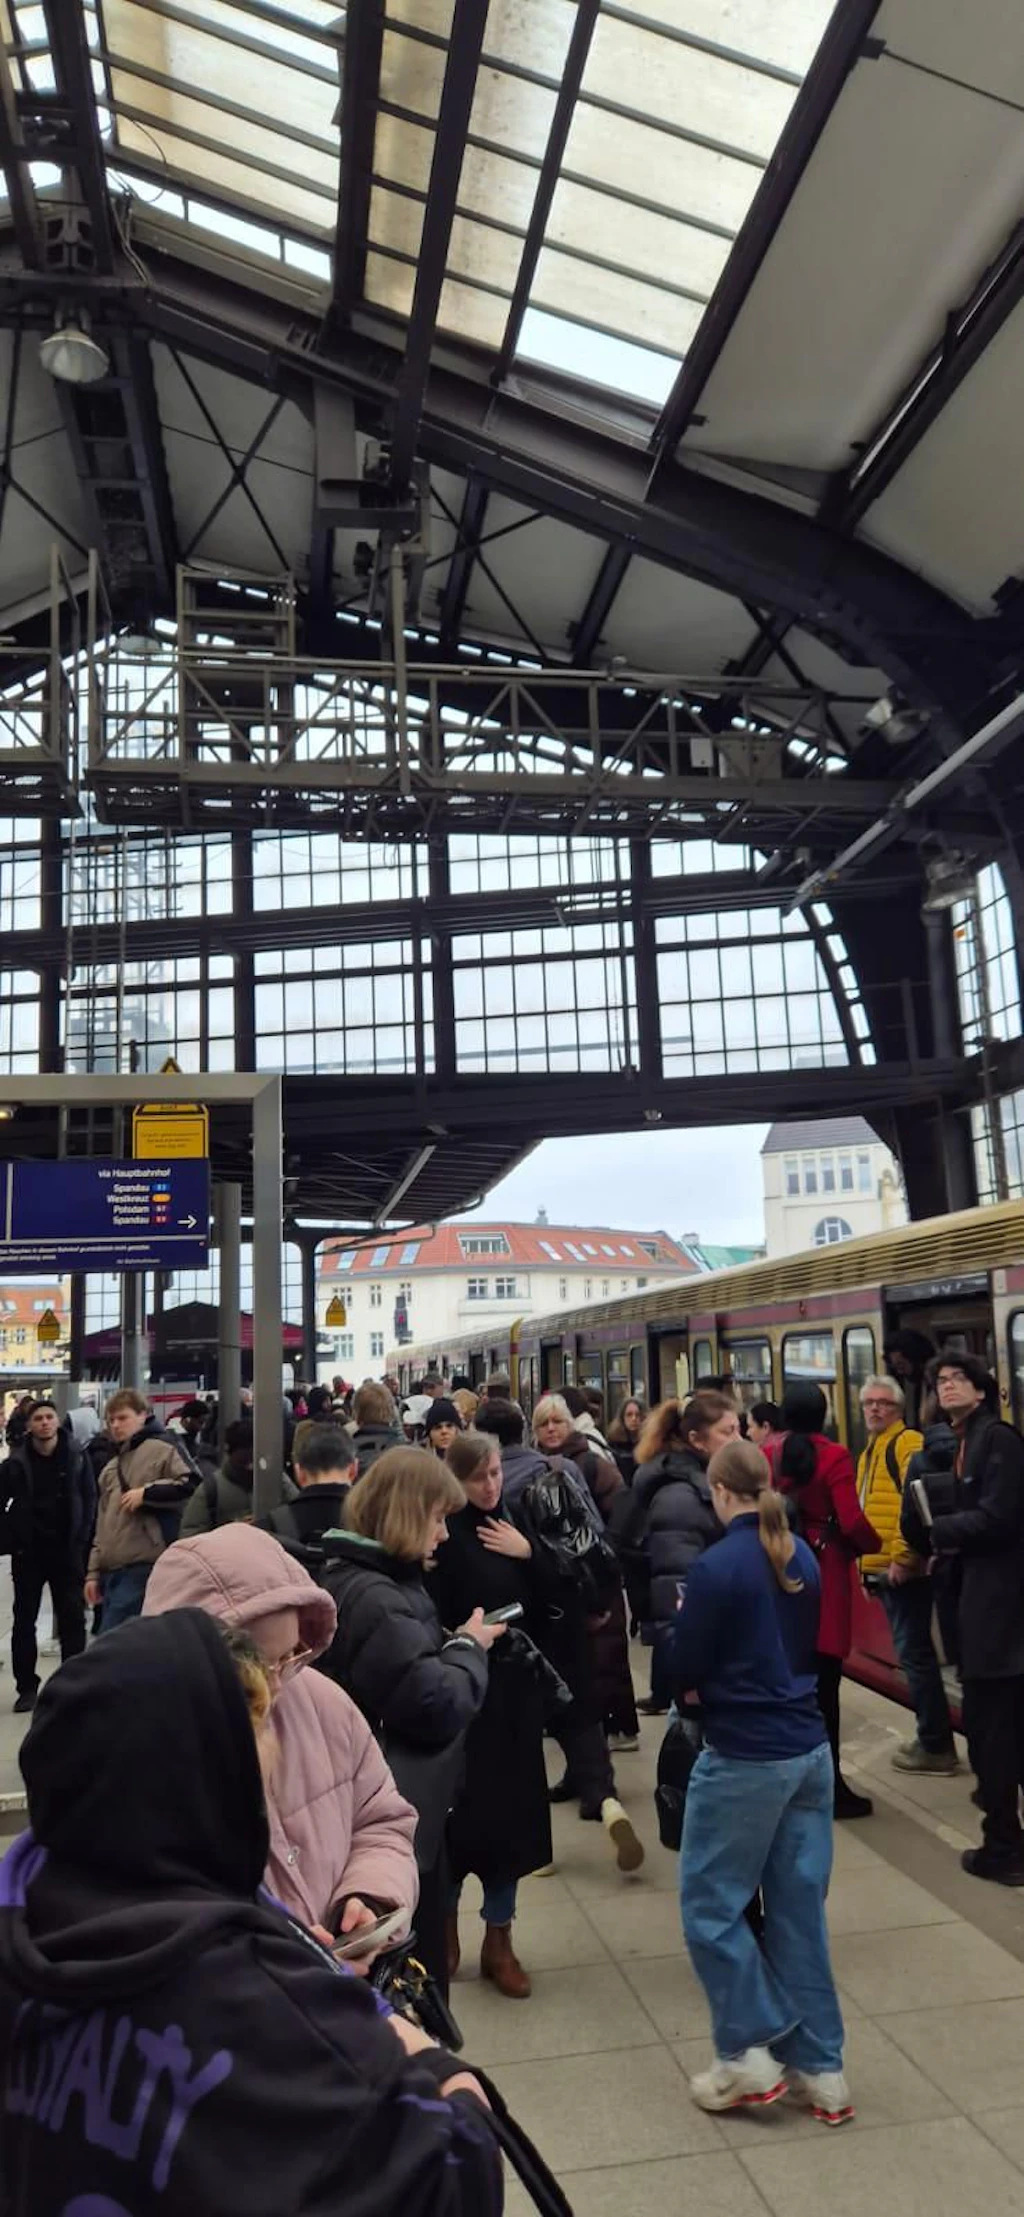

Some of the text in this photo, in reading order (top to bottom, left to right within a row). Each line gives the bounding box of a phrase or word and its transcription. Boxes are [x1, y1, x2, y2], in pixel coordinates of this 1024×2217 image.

[98, 1167, 171, 1179] via Hauptbahnhof
[113, 1184, 150, 1193] Spandau
[106, 1194, 150, 1203] Westkreuz
[113, 1205, 150, 1214] Potsdam
[113, 1215, 150, 1225] Spandau
